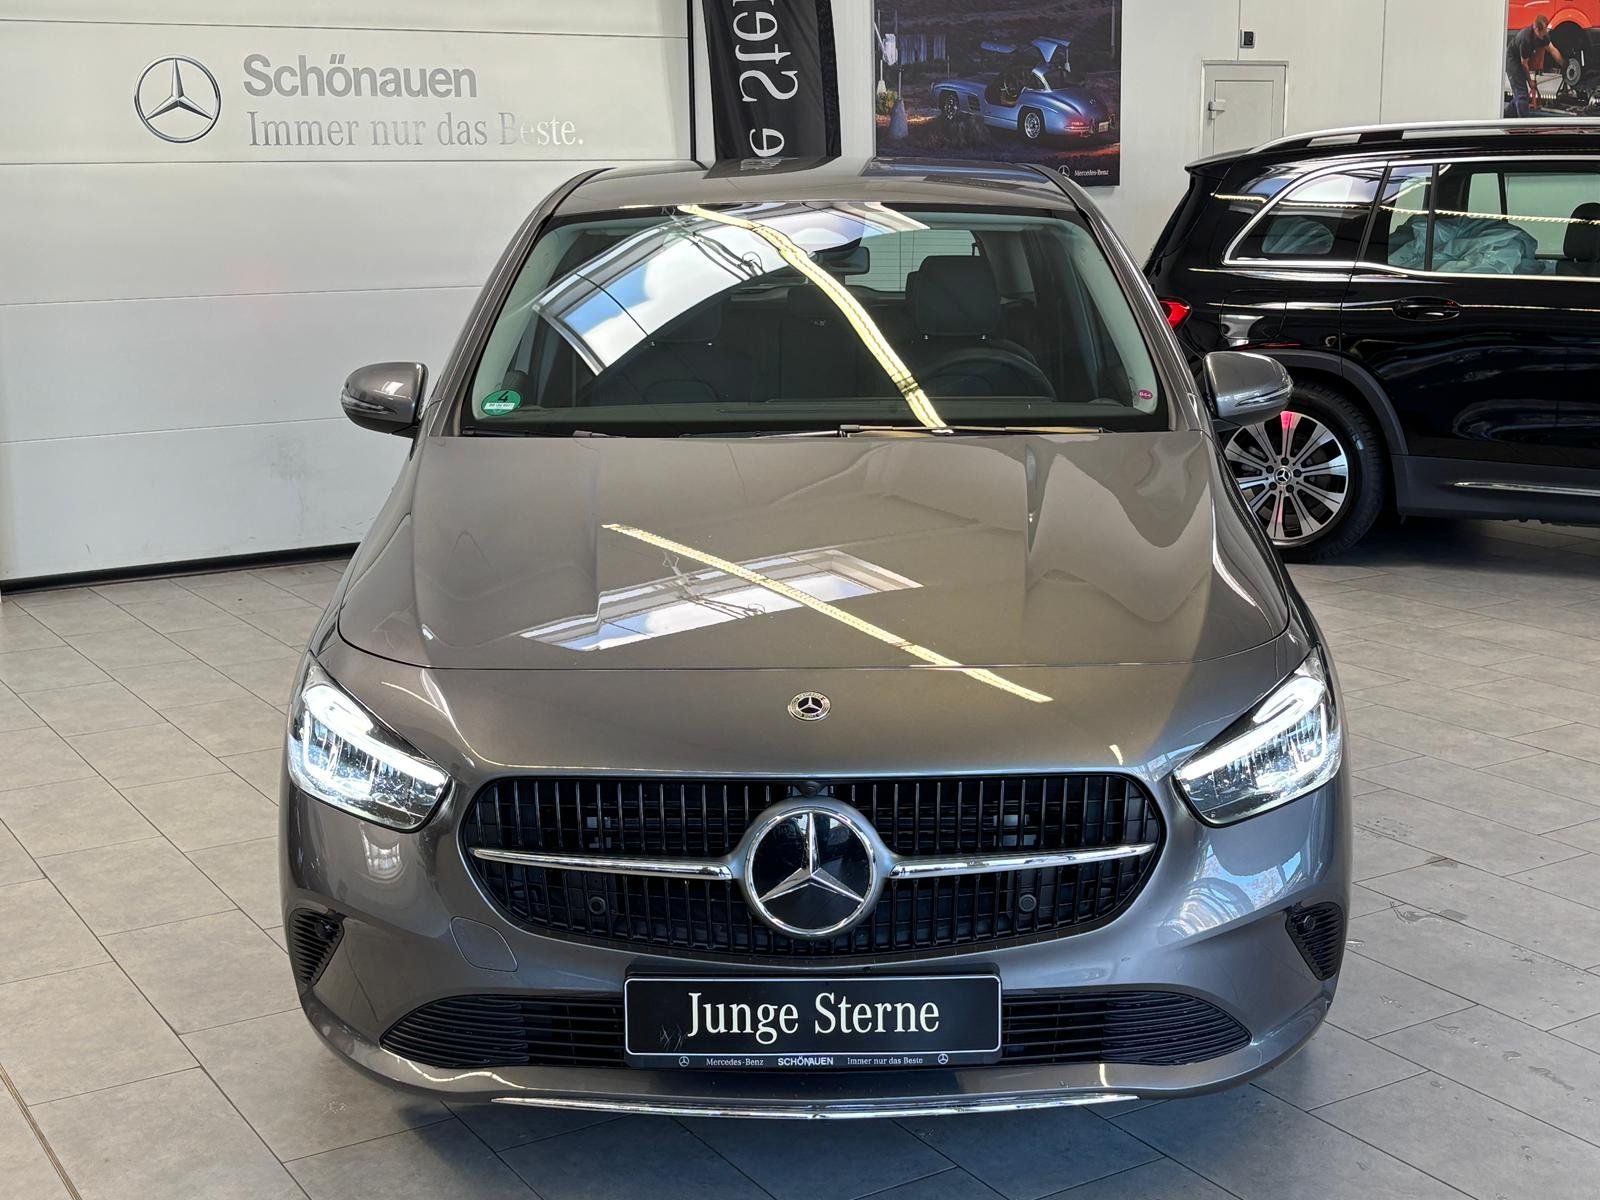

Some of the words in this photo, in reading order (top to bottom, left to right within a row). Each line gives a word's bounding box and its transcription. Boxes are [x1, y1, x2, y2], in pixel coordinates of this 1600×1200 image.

[243, 53, 477, 98] Schönauen
[246, 111, 360, 146] Immer
[369, 119, 427, 146] nur
[437, 111, 488, 146] das
[498, 111, 584, 146] Beste.
[497, 390, 509, 403] 4
[687, 992, 799, 1045] Junge
[814, 992, 940, 1034] Sterne
[706, 1058, 764, 1066] Mercedes-Benz
[777, 1056, 834, 1066] SCHÖNAUEN
[873, 1057, 887, 1065] nur
[888, 1057, 901, 1065] das
